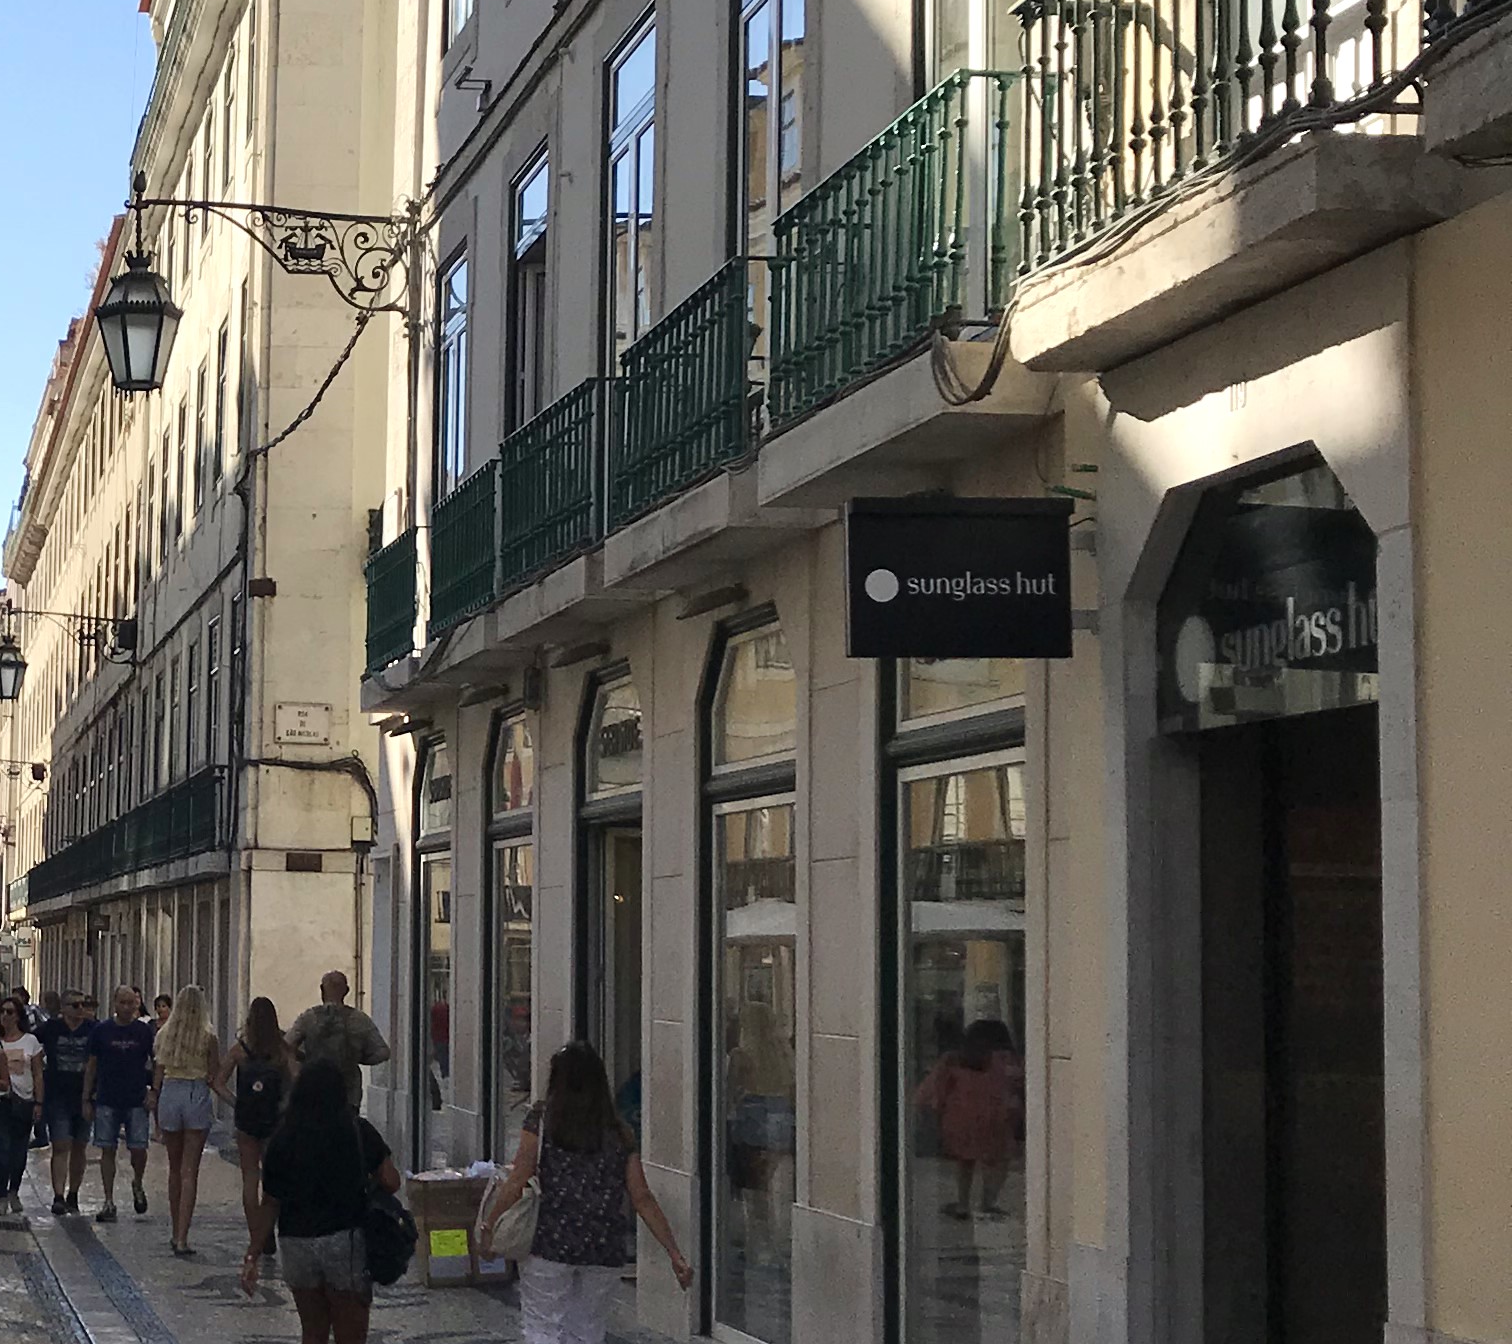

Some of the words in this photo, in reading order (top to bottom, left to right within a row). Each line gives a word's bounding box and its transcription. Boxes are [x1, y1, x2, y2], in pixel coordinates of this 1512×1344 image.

[907, 571, 1010, 601] sunglass
[1016, 571, 1056, 595] hut
[1221, 596, 1343, 672] sunglass
